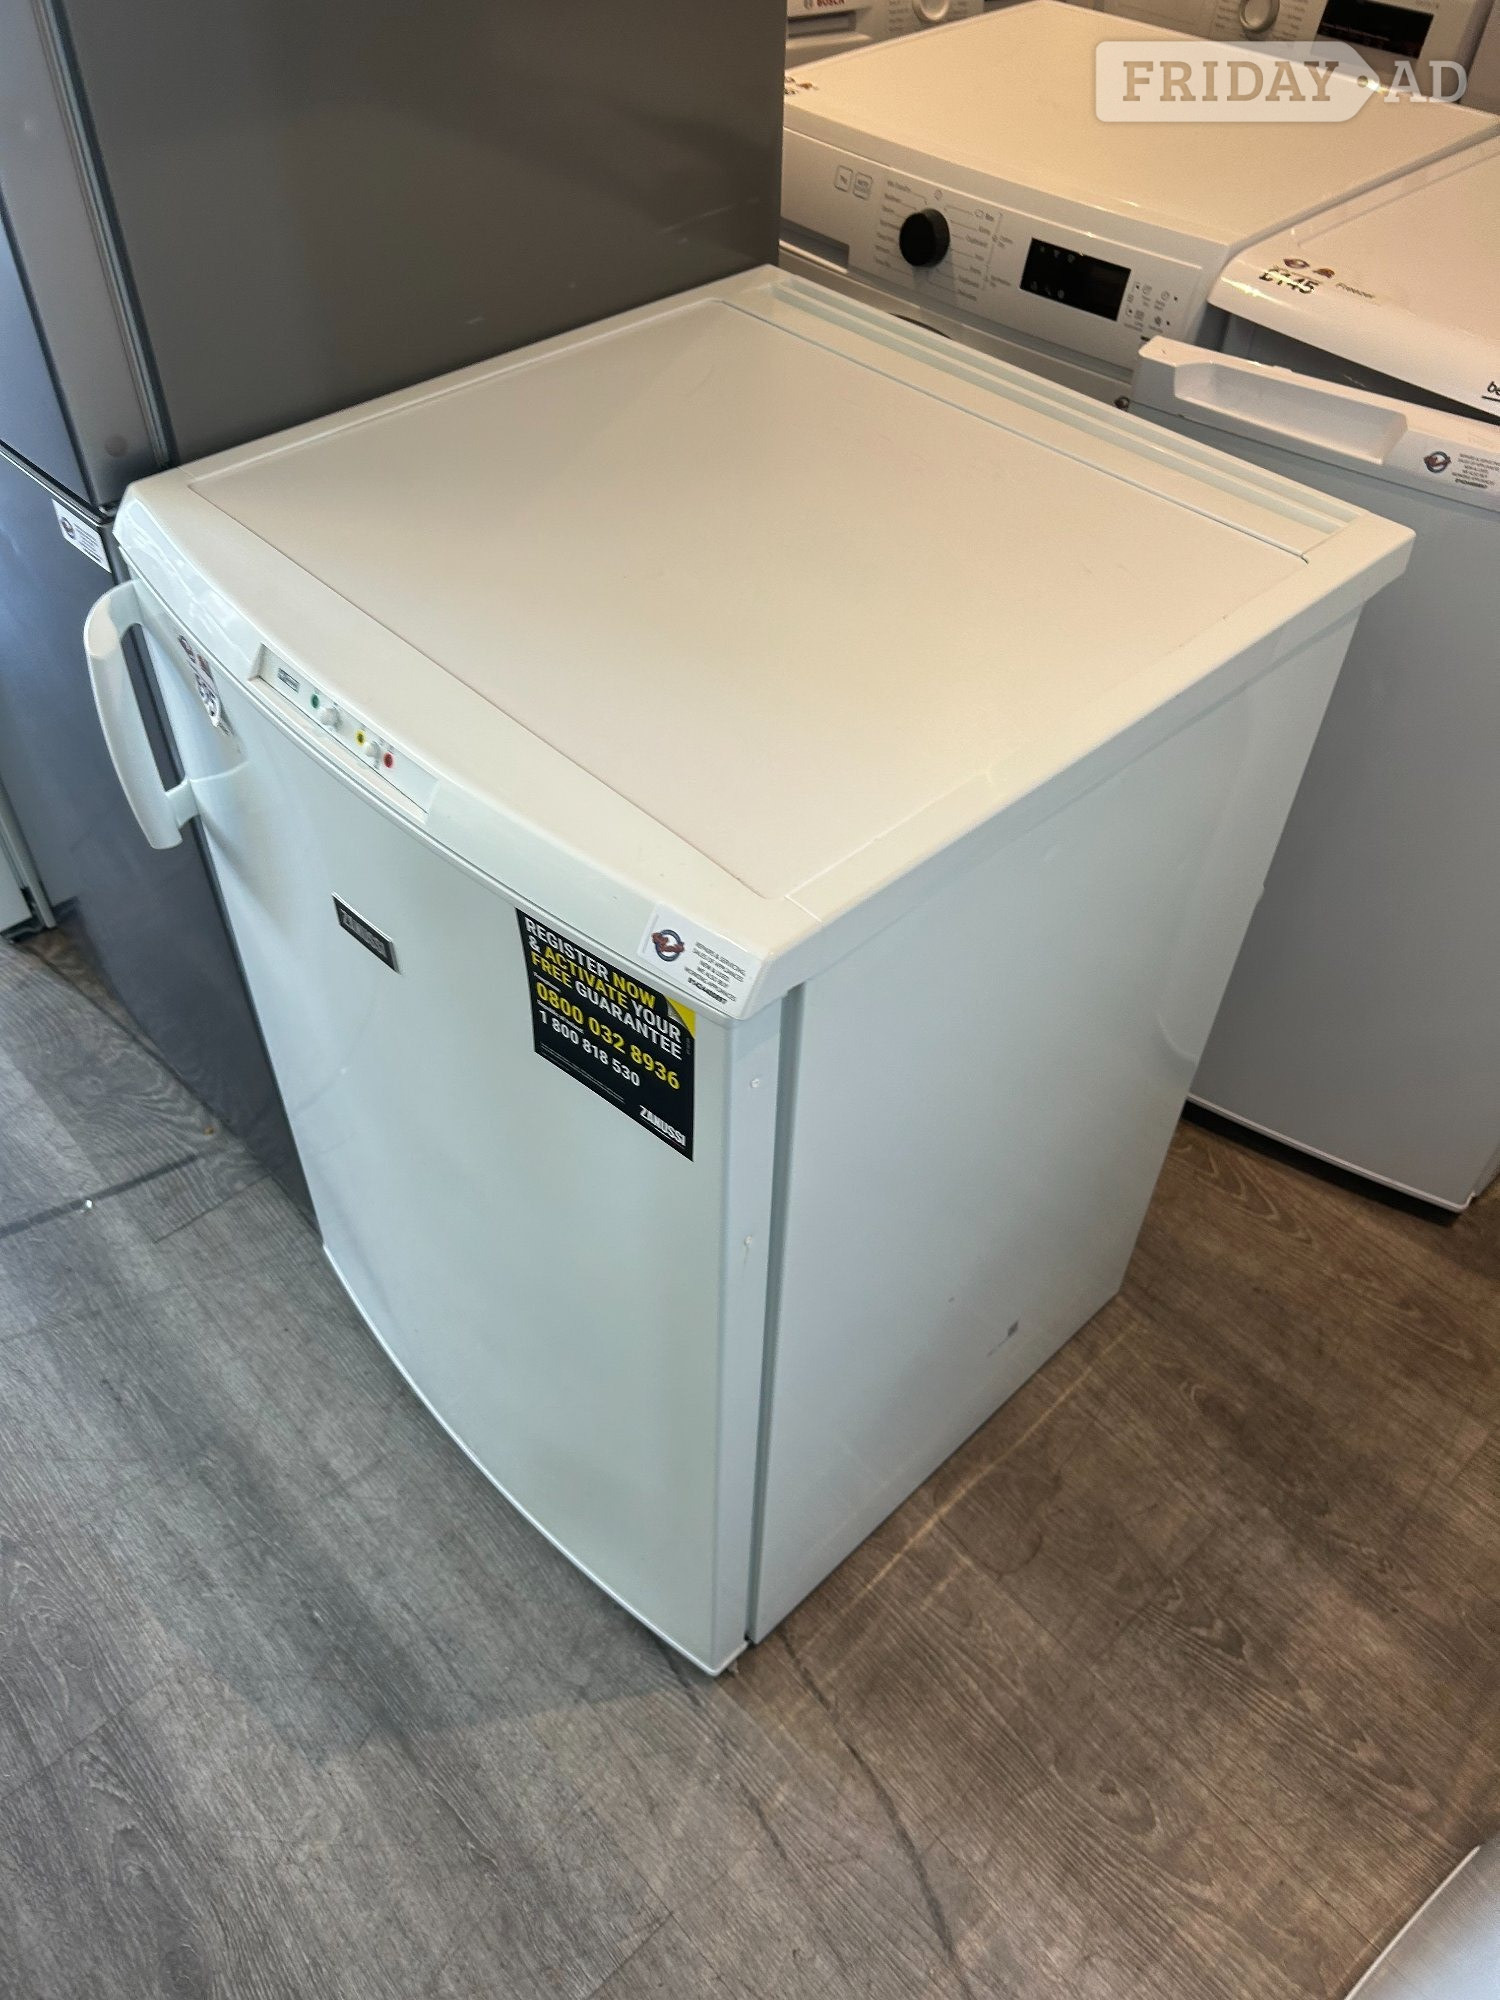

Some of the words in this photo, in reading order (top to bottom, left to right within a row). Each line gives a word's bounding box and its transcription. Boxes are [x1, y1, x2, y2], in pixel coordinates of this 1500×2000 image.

[524, 916, 609, 982] REGISTER
[612, 971, 656, 1009] NOW
[528, 935, 541, 954] &
[545, 945, 629, 1010] ACTIVATE
[631, 999, 682, 1044] YOUR
[530, 951, 573, 989] FREE
[575, 980, 683, 1061] GUARANTEE
[536, 981, 584, 1025] 0800
[588, 1016, 626, 1054] 032
[630, 1044, 681, 1090] 8936
[539, 1009, 548, 1024] 1
[551, 1017, 580, 1045] 800
[582, 1038, 609, 1065] 818
[611, 1057, 641, 1087] 530
[639, 1104, 687, 1147] ZANUSSI
